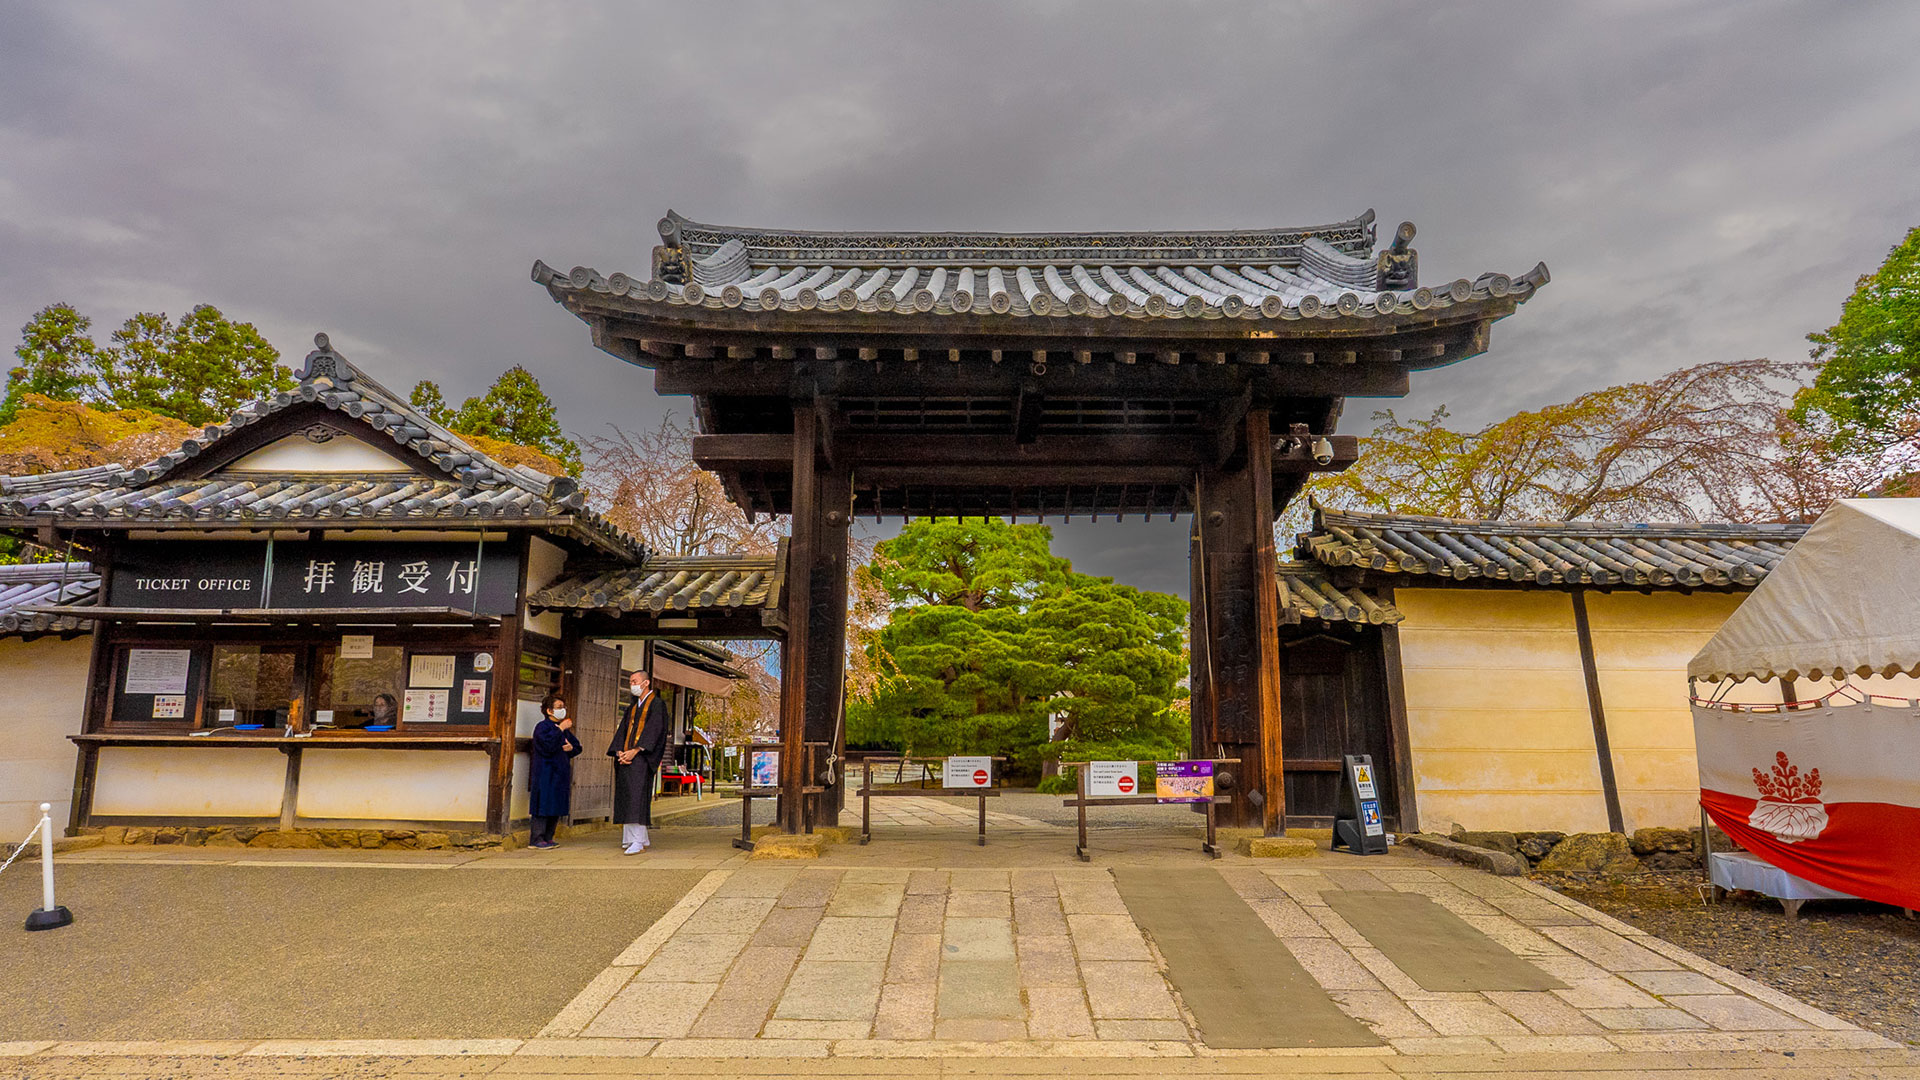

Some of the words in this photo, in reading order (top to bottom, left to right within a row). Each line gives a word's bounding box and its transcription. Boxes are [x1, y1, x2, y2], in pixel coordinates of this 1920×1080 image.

[136, 578, 190, 590] TICKET
[198, 579, 251, 591] OFFICE
[303, 560, 479, 594] 拝観受付
